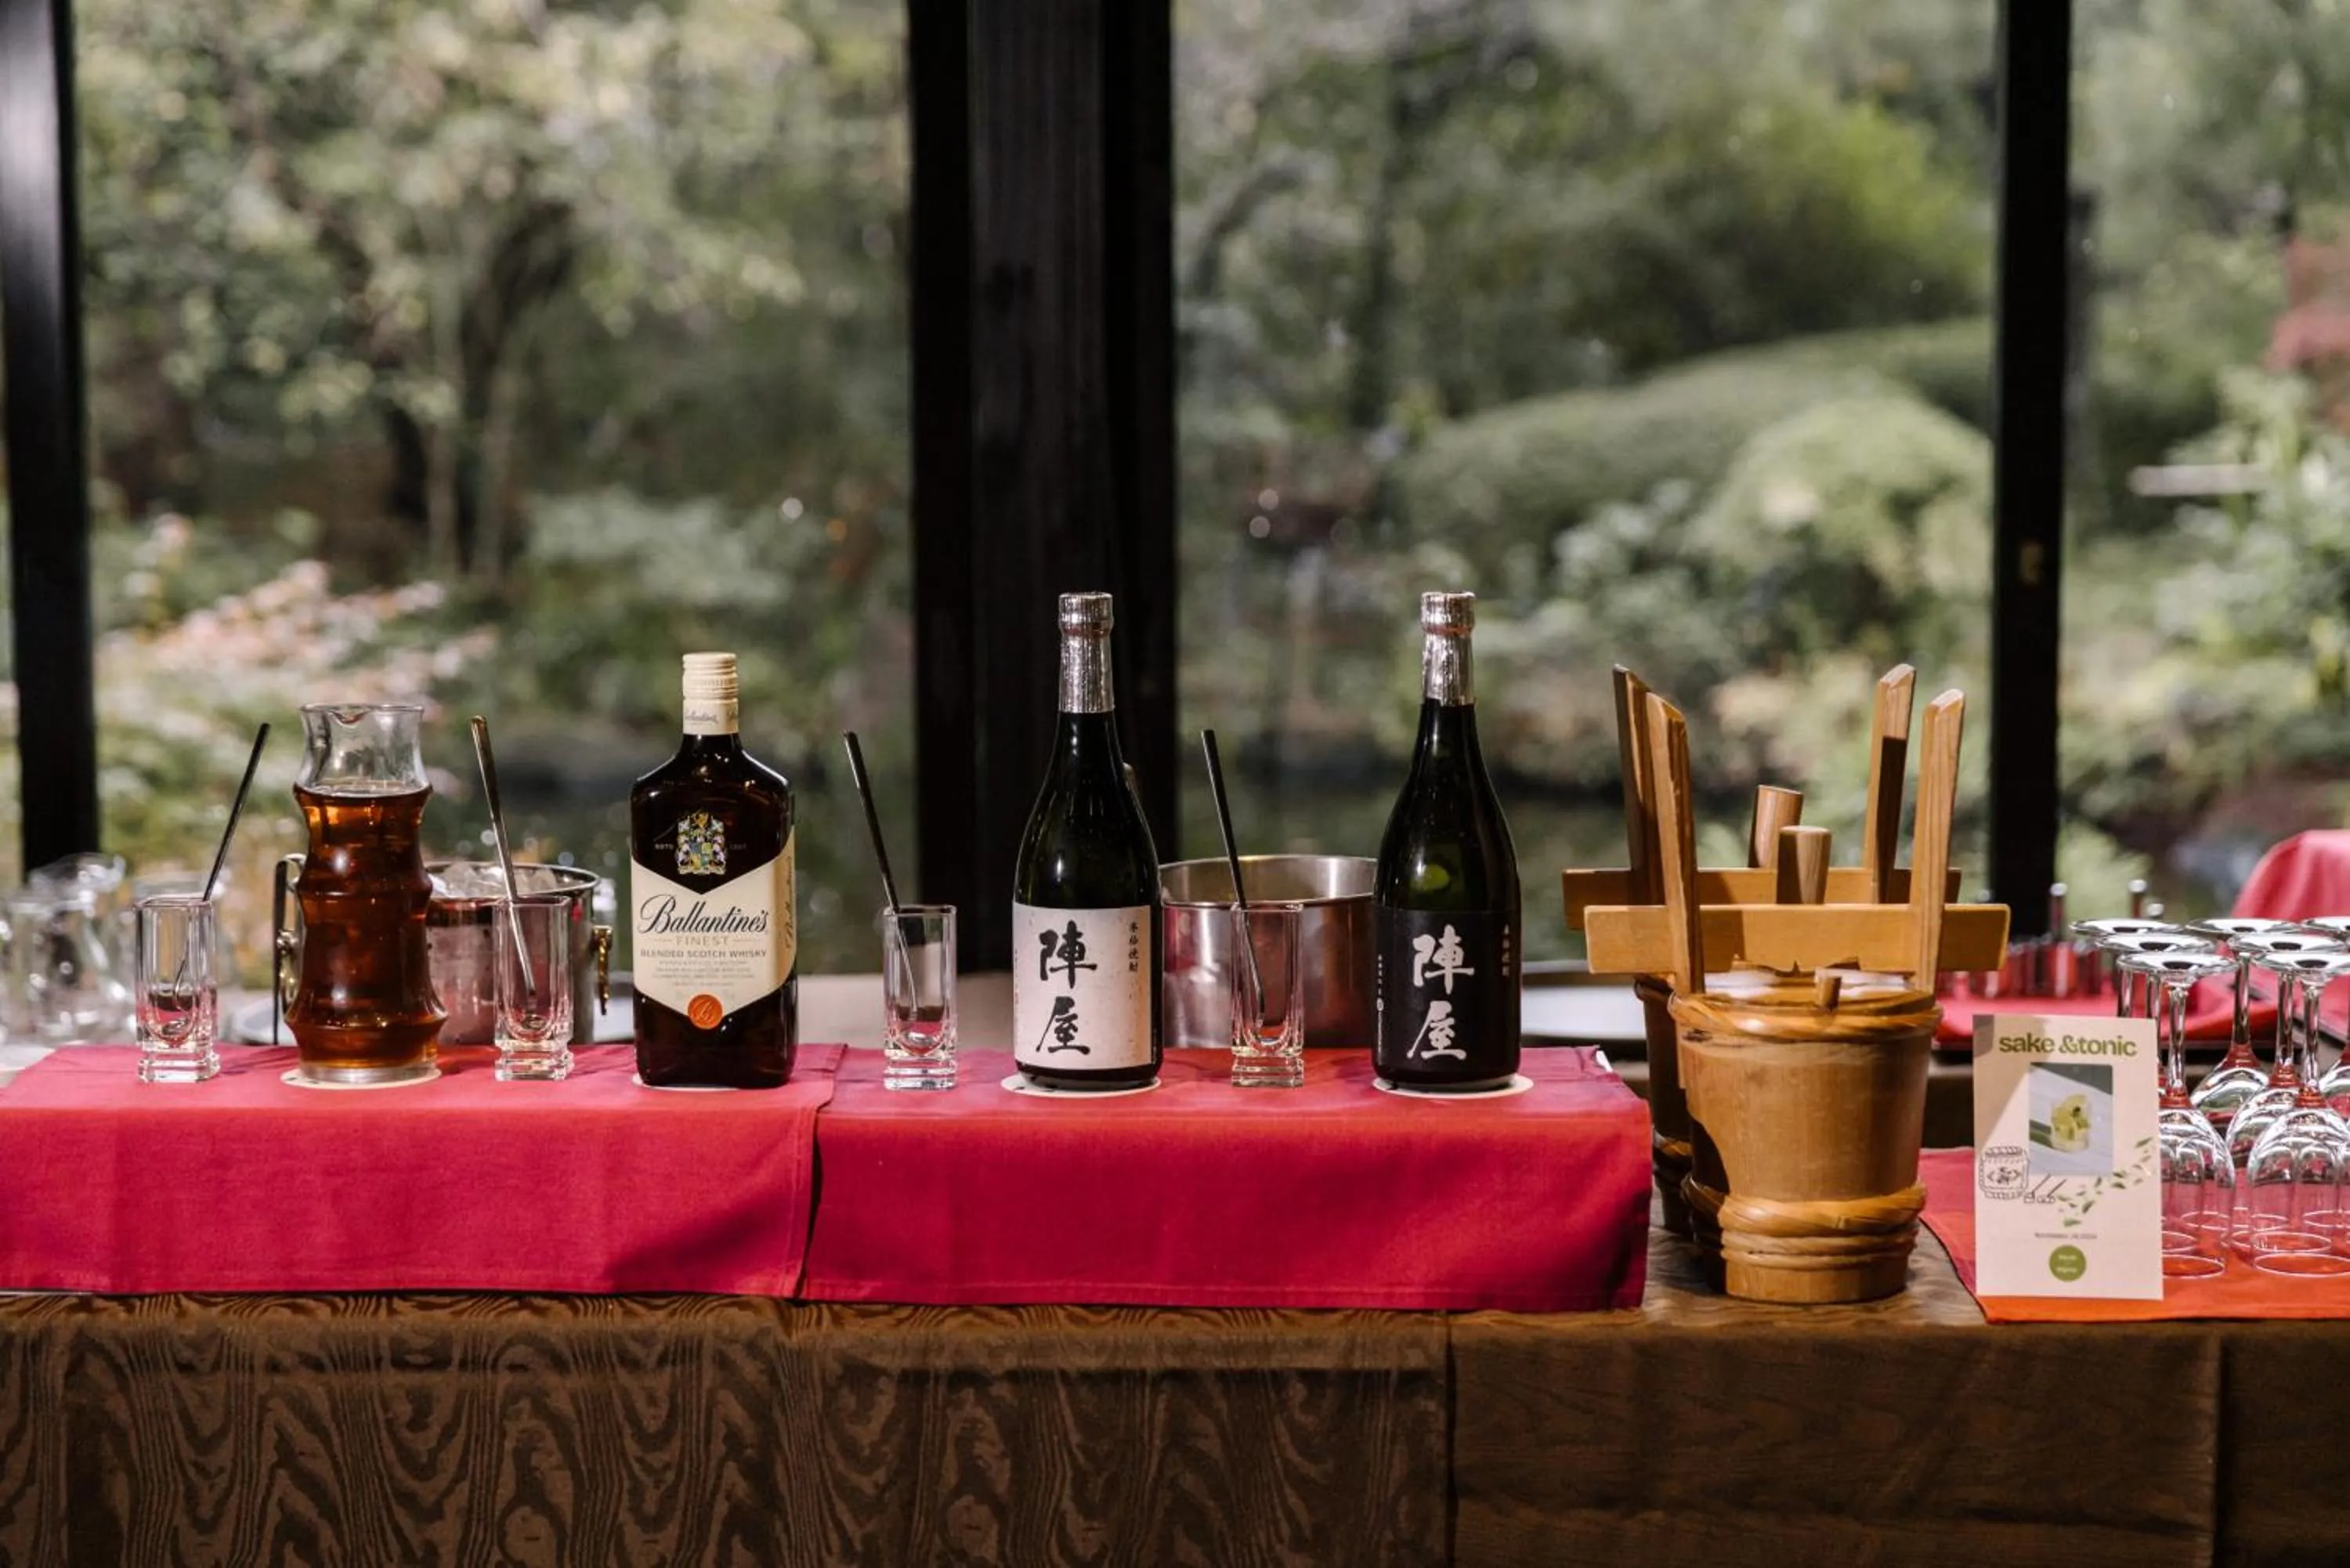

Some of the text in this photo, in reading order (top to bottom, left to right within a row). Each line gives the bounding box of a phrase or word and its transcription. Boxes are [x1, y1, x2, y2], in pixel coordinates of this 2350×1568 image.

[638, 894, 769, 934] Ballantine's
[640, 949, 684, 958] BLENDED
[729, 949, 767, 958] WHISKY
[675, 936, 729, 946] FINEST
[1035, 919, 1098, 1056] 陣屋
[1407, 923, 1475, 1060] 陣屋
[1999, 1032, 2055, 1054] sake
